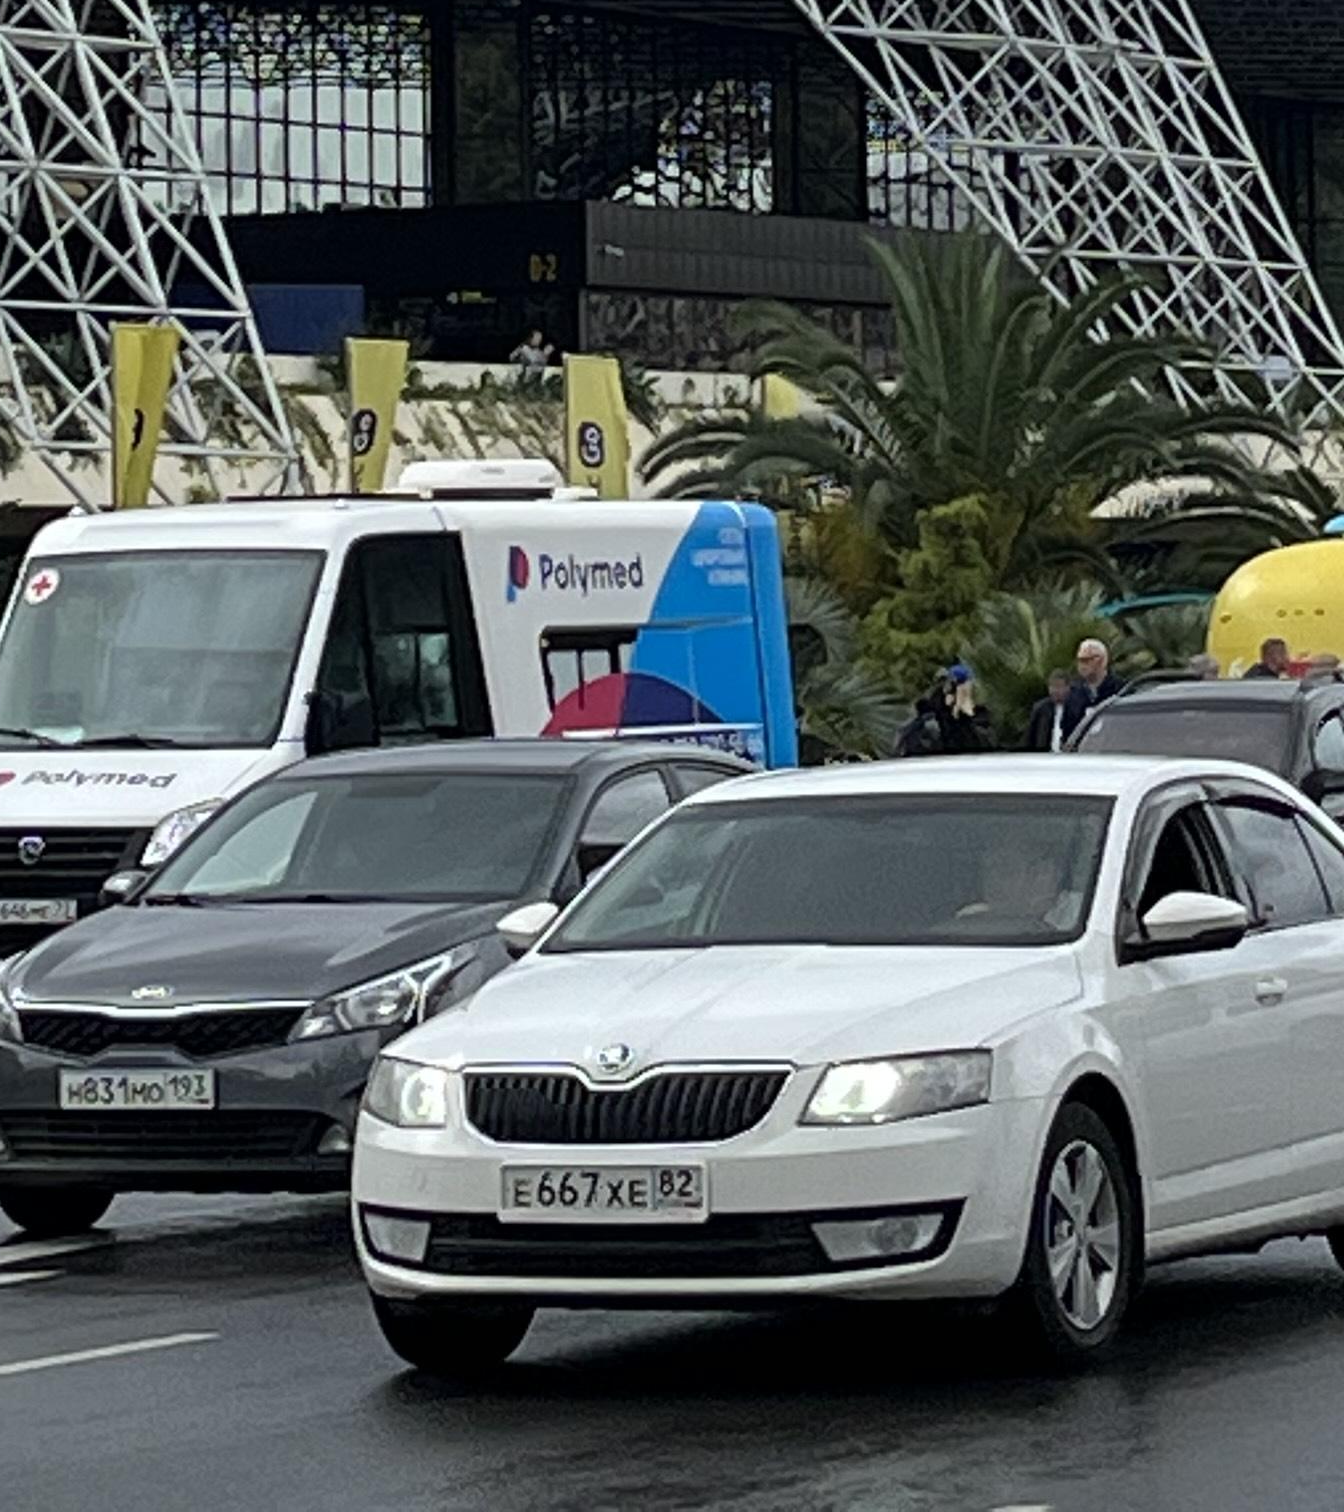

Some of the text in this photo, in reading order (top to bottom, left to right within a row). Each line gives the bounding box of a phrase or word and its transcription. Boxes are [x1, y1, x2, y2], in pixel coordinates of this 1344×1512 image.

[538, 552, 645, 598] Polymed
[20, 767, 178, 789] Polymed
[659, 1168, 694, 1198] 82
